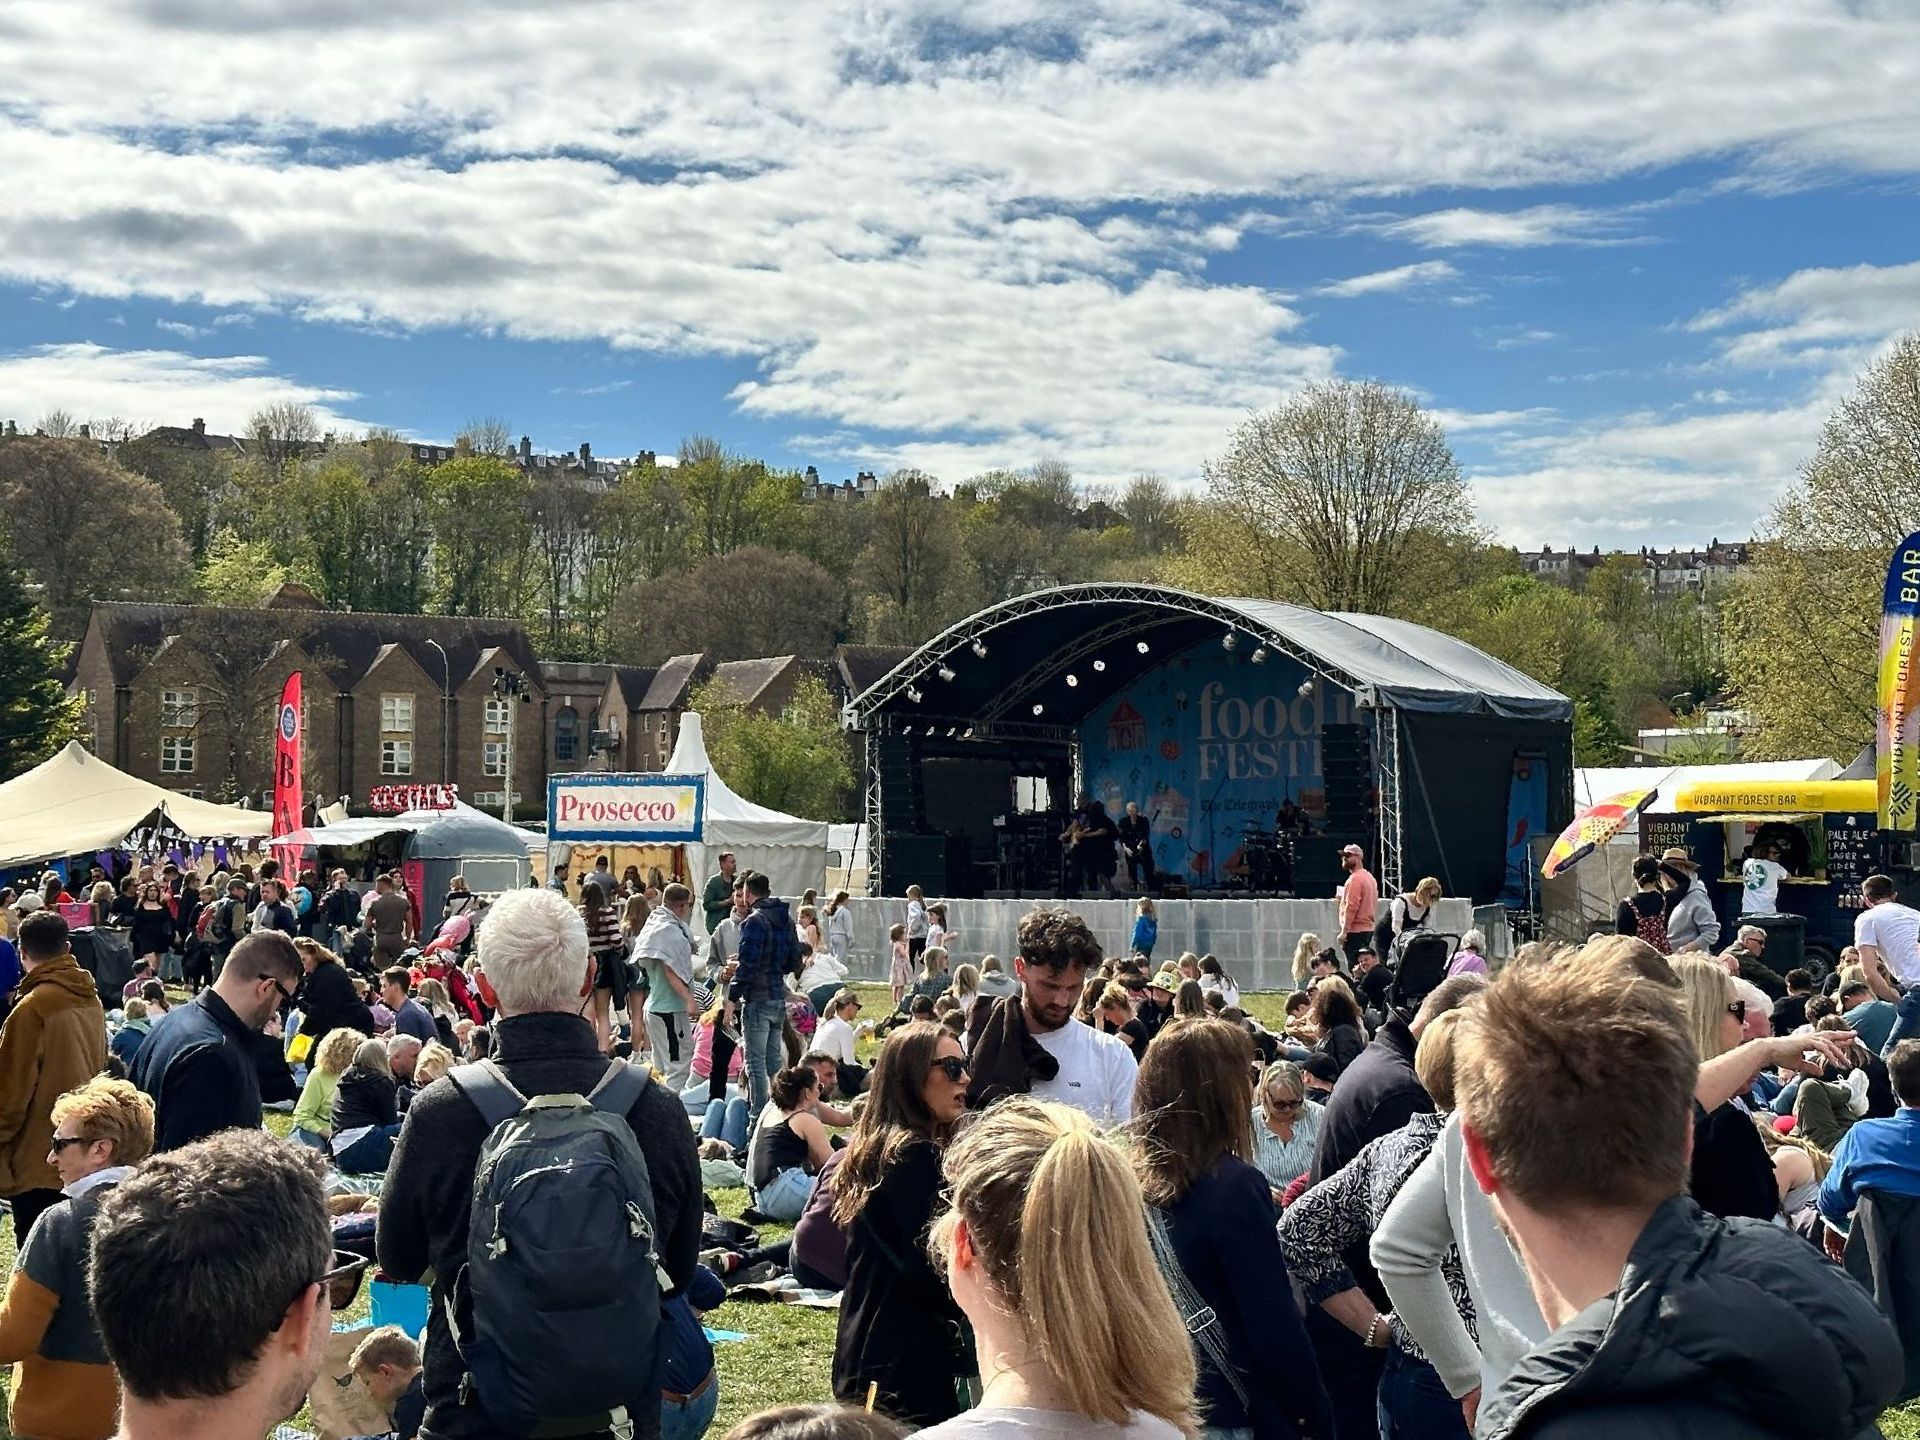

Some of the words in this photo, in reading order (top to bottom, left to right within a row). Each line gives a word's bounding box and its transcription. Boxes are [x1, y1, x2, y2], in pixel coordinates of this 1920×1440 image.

[1900, 549, 1920, 603] BAR
[1896, 626, 1912, 693] FOREST
[1197, 675, 1363, 740] foodi
[1892, 697, 1906, 775] VIBRANT
[1693, 794, 1735, 806] VIBRANT
[1737, 794, 1775, 806] FOREST
[1777, 794, 1797, 806] BAR
[559, 794, 676, 822] Prosecco
[1647, 822, 1691, 833] VIBRANT
[1648, 833, 1685, 845] FOREST
[1827, 830, 1848, 841] PALE
[1851, 829, 1869, 840] ALE
[1828, 840, 1848, 851] IPA
[1827, 851, 1857, 861] LAGER
[1827, 861, 1856, 870] CIDER
